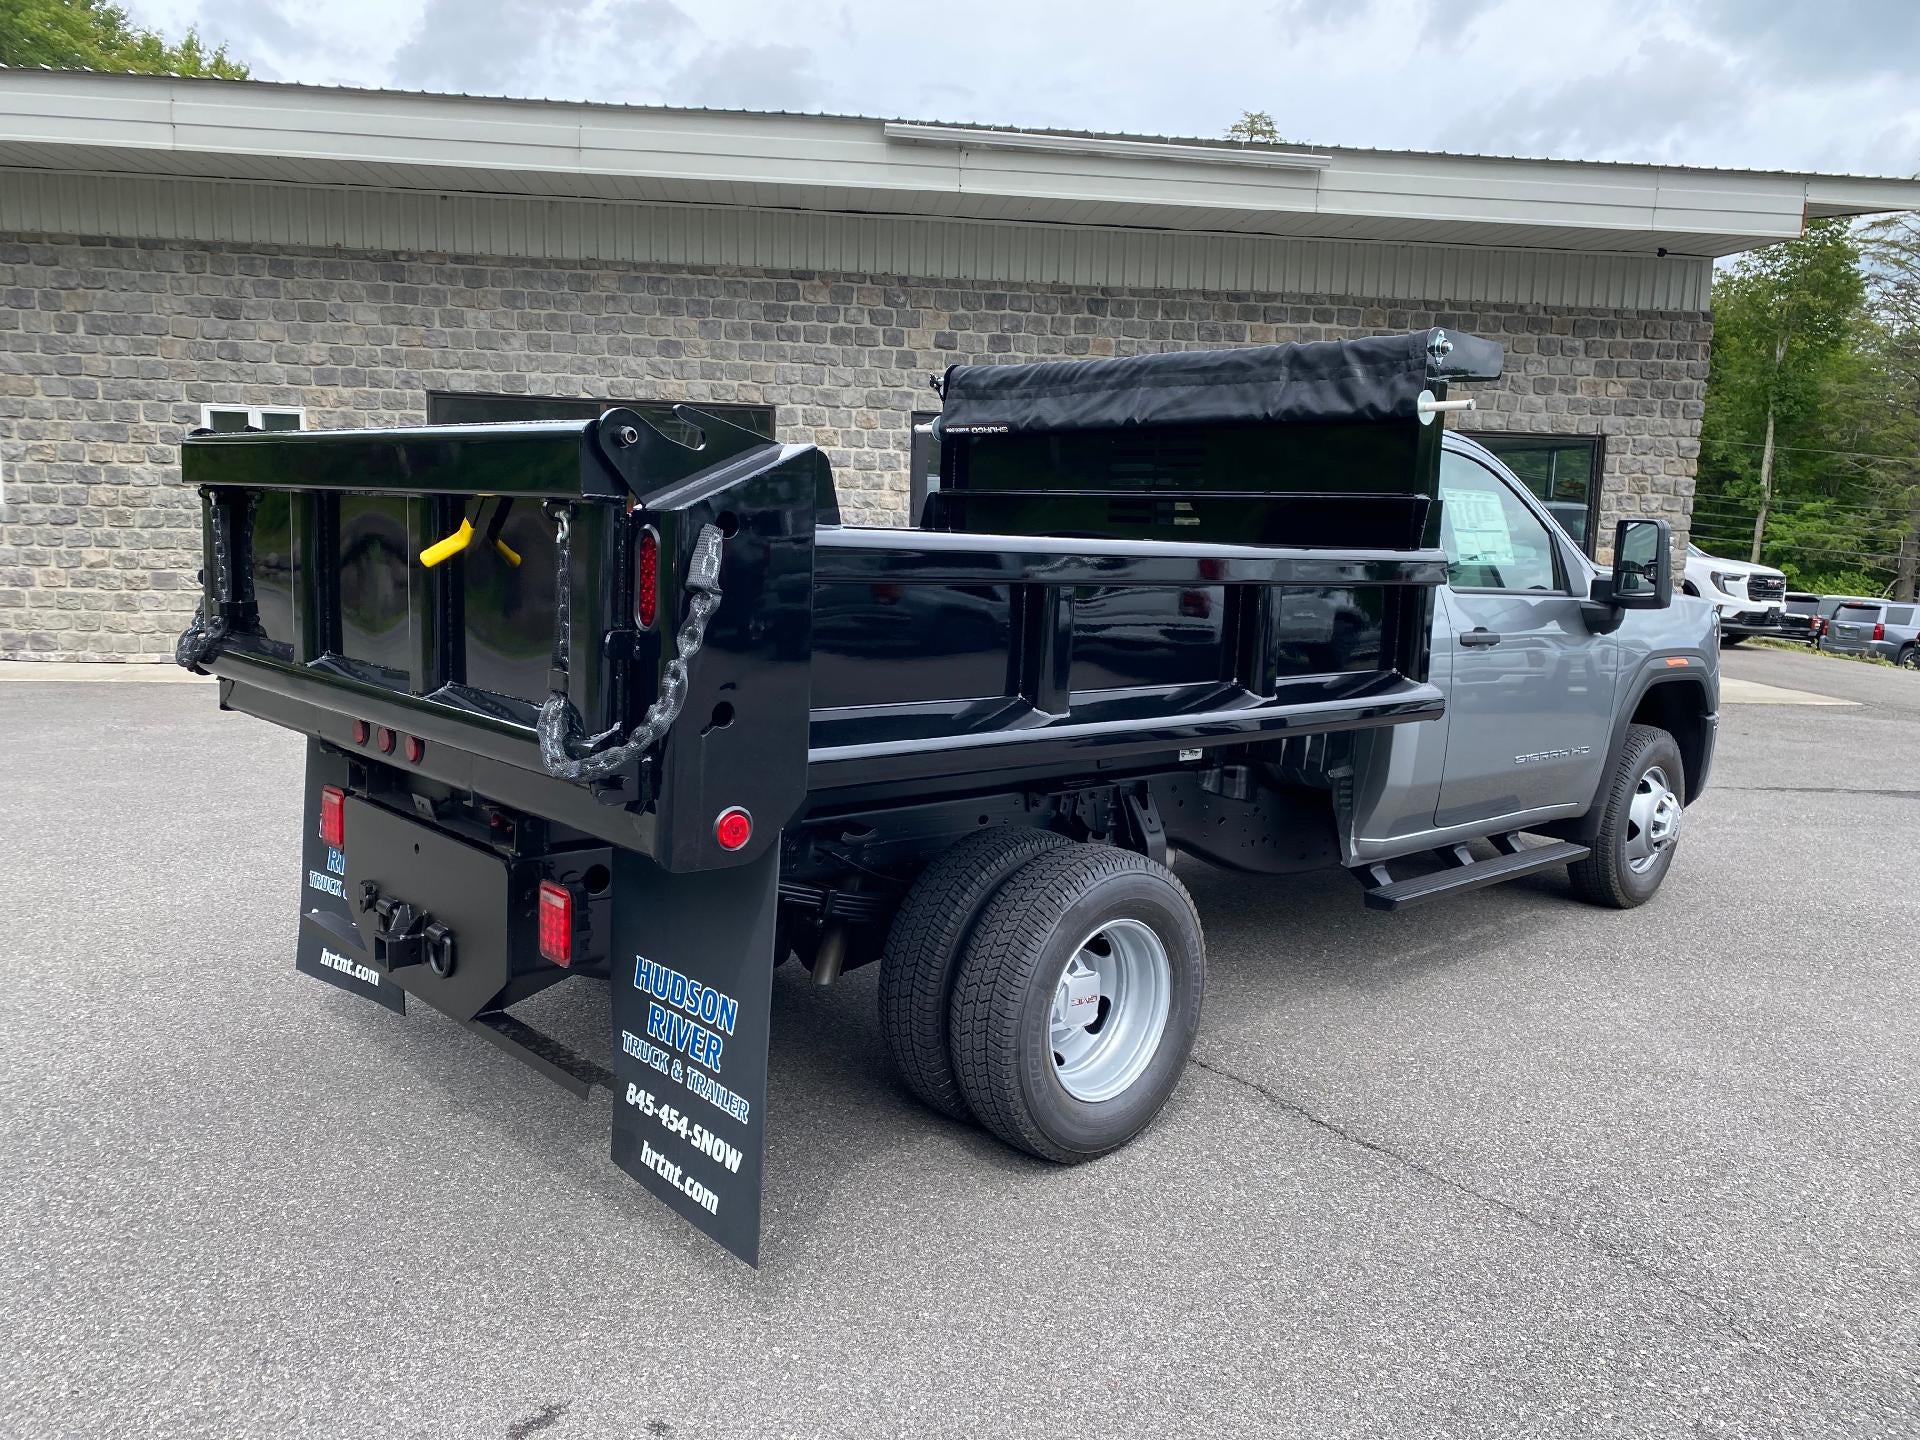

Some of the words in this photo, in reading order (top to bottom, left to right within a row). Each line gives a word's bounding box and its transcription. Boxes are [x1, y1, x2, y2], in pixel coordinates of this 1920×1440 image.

[1513, 750, 1569, 764] SIERRA
[1570, 746, 1591, 757] HD
[309, 870, 343, 897] TRUCK
[319, 947, 380, 986] hrtnt.com
[633, 954, 739, 1036] HUDSON
[647, 1000, 723, 1073] RIVER
[621, 1030, 669, 1075] TRUCK
[671, 1059, 683, 1084] &
[686, 1066, 750, 1124] TRAILER
[625, 1082, 743, 1174] 845-454-SNOW
[640, 1140, 719, 1215] hrtnt.com
